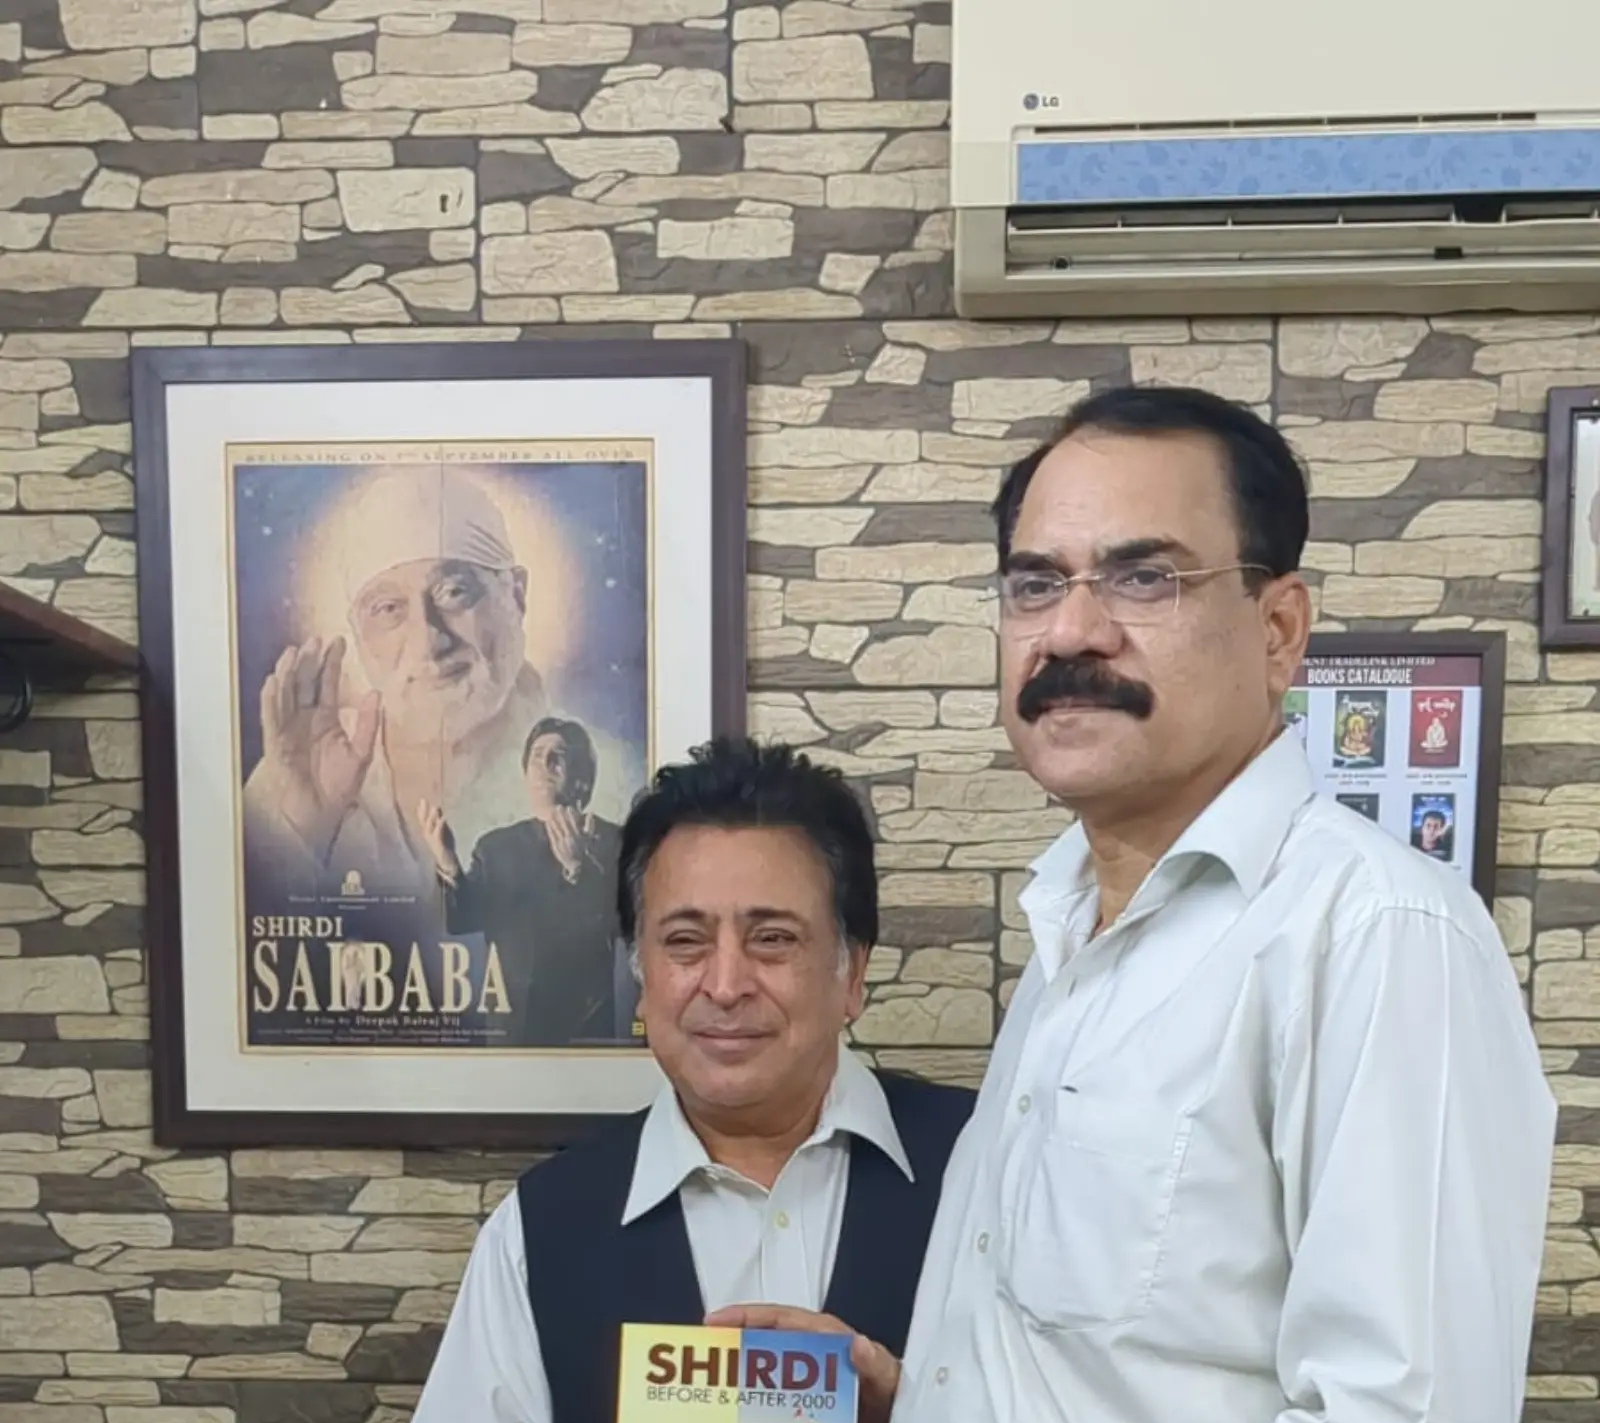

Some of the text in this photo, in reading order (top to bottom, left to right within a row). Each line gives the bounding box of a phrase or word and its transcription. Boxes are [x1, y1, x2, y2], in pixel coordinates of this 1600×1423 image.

[1042, 96, 1059, 107] LG
[360, 452, 386, 462] ON
[424, 450, 532, 461] SEPTEMBER
[1307, 668, 1413, 684] BOOKS CATALOGUE
[252, 916, 344, 938] SHIRDI
[646, 1343, 838, 1392] SHIRDI
[647, 1386, 837, 1410] BEFORE & AFTER 2000
